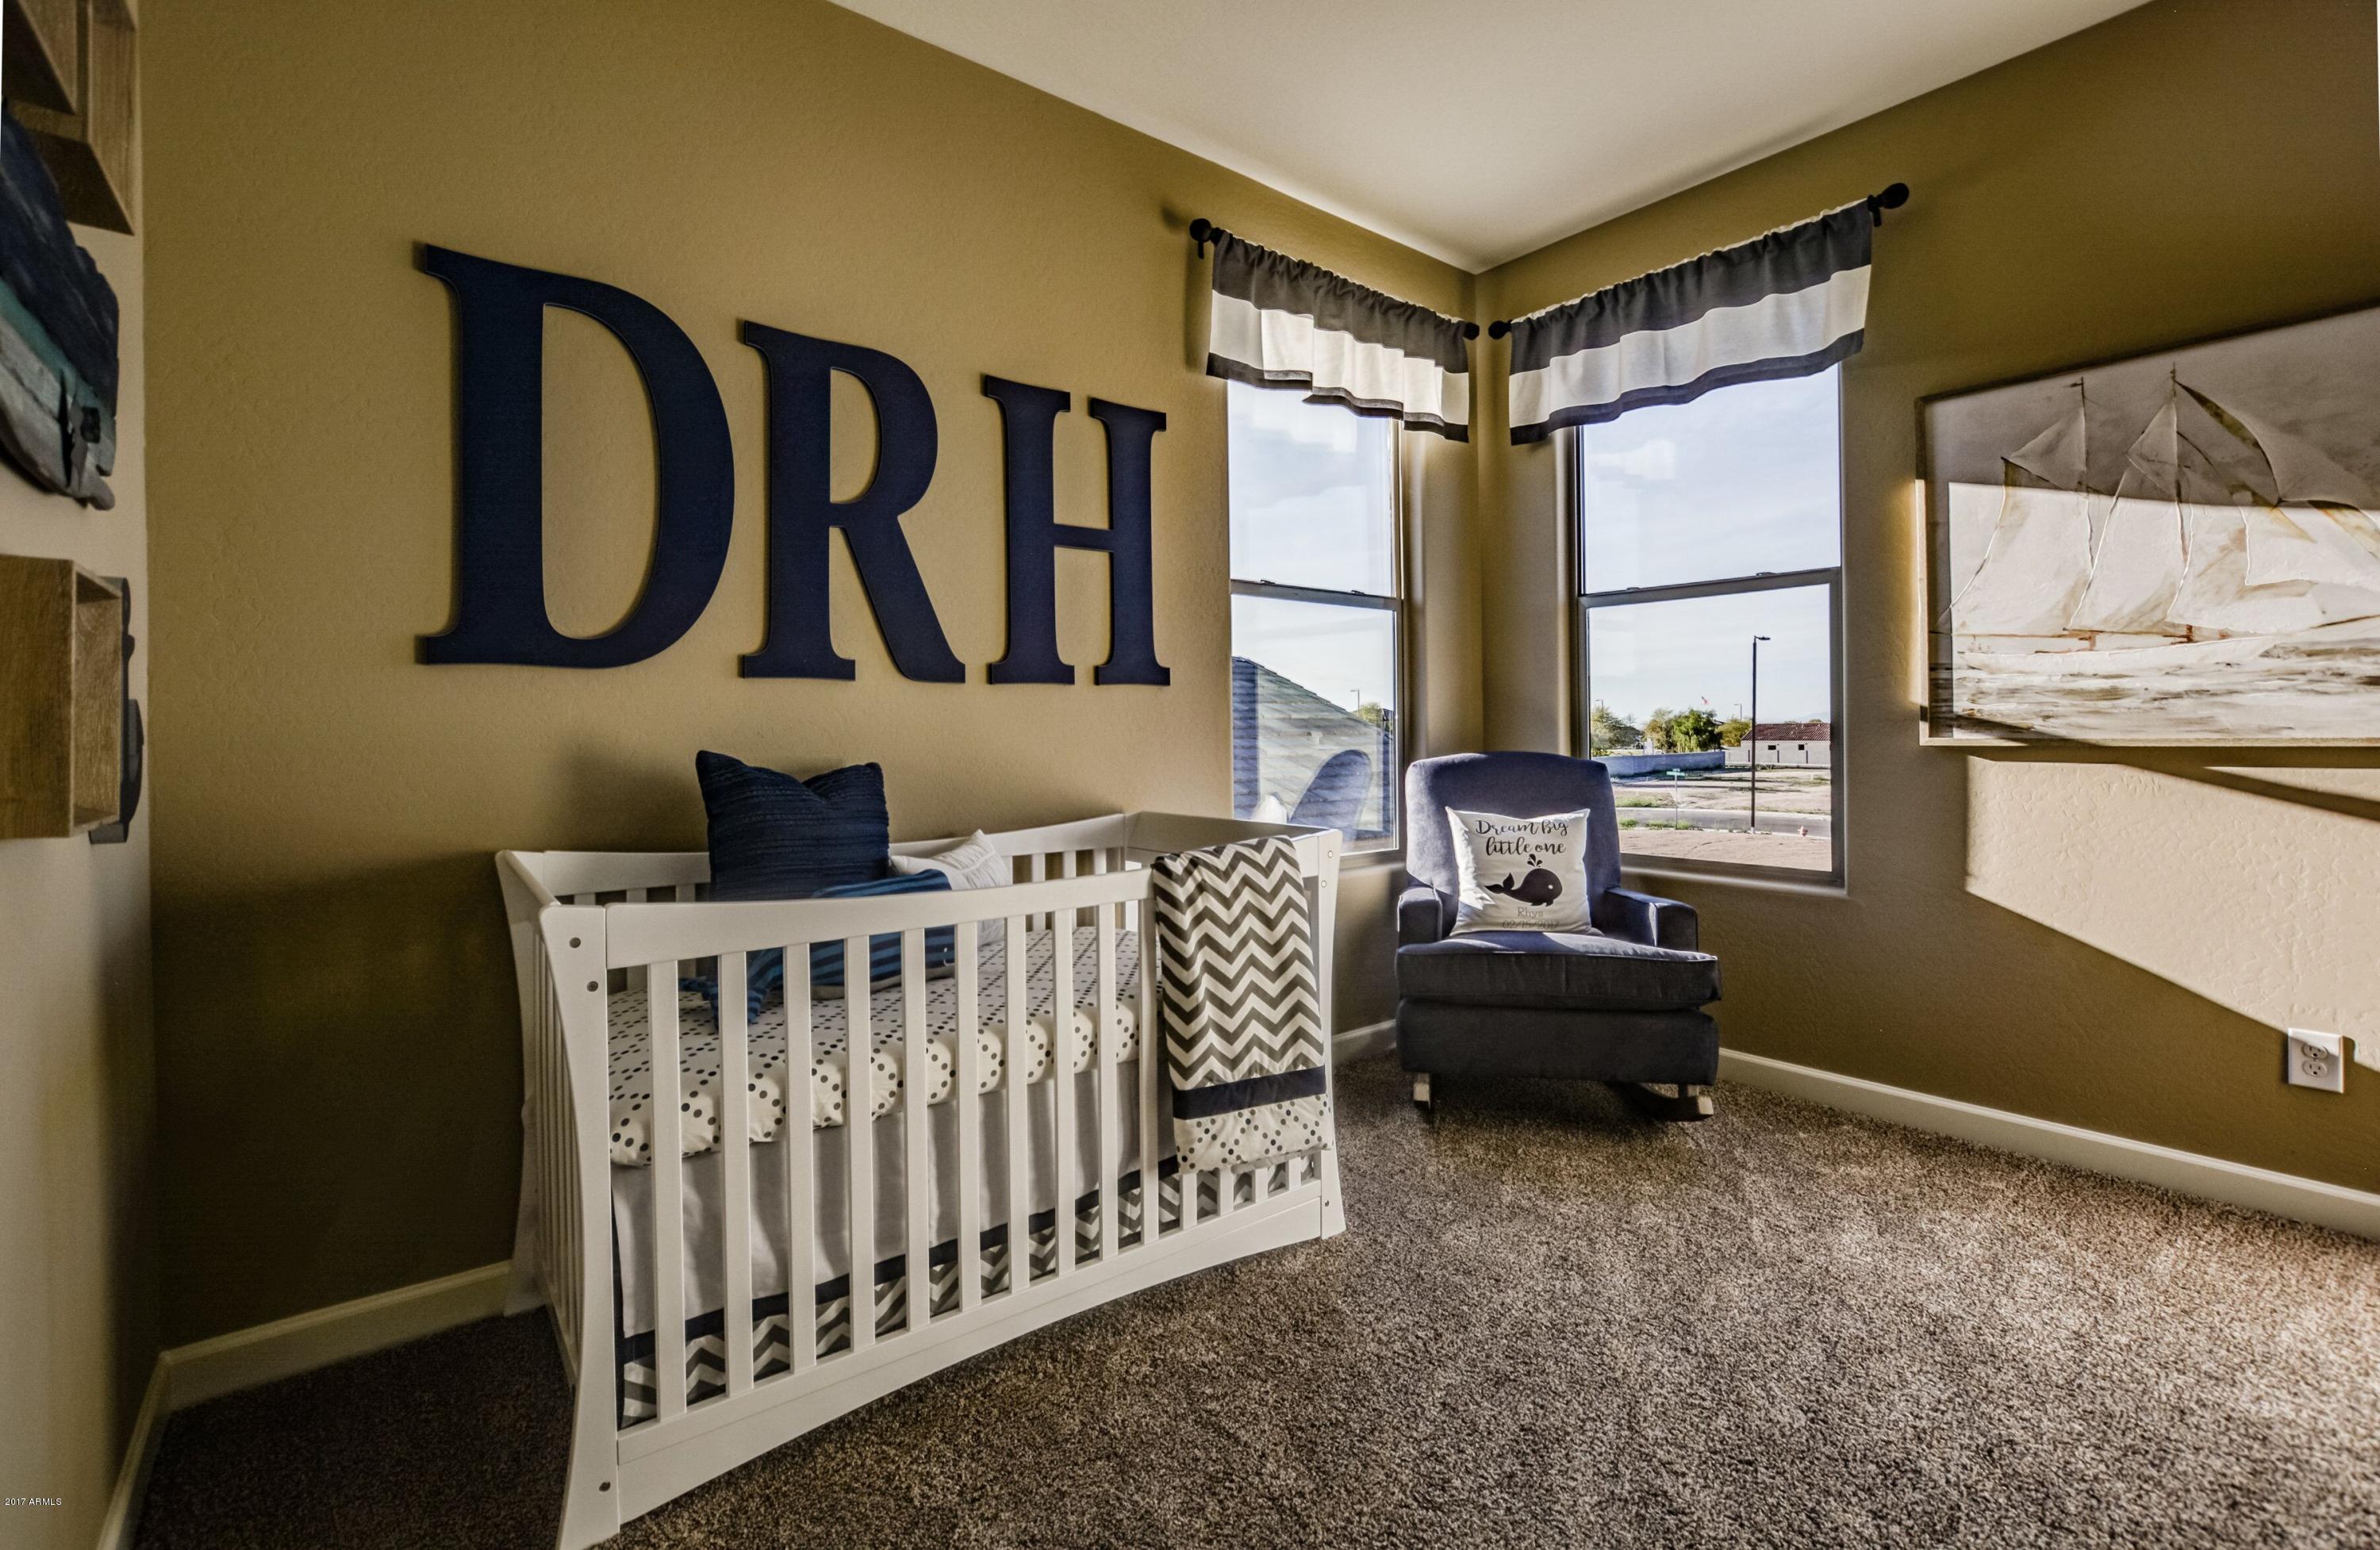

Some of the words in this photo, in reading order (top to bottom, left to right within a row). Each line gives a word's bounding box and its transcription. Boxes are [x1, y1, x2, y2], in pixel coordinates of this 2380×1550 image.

[420, 243, 1170, 686] DRH
[1475, 819, 1539, 835] Dream
[1541, 819, 1568, 836] Big
[1486, 836, 1532, 856] little
[1534, 842, 1566, 855] one
[1517, 907, 1543, 919] Rhys
